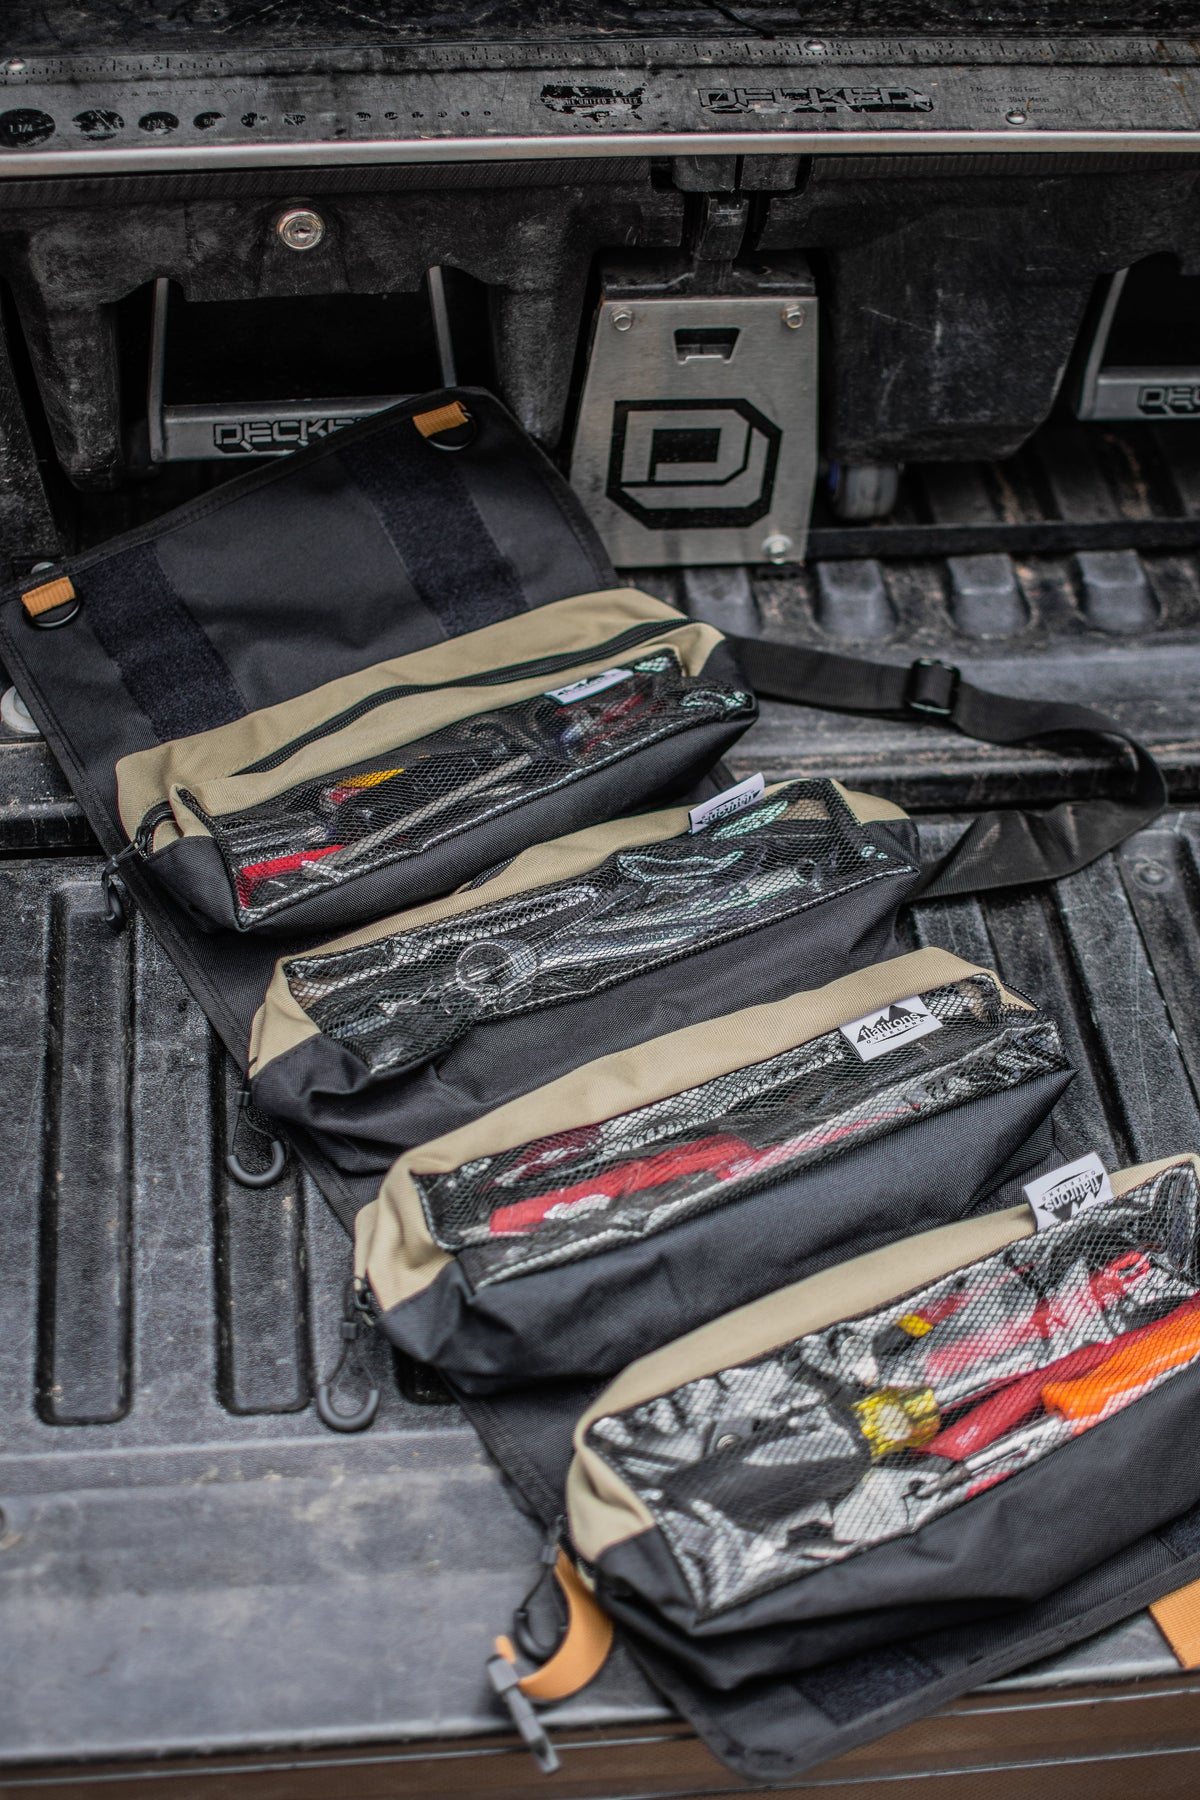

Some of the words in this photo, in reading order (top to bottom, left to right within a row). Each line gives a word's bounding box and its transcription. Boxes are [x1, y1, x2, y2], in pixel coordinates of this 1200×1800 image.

[859, 1011, 918, 1041] flatirons
[866, 1018, 925, 1044] OVERLAND
[1045, 1177, 1101, 1213] flatirons
